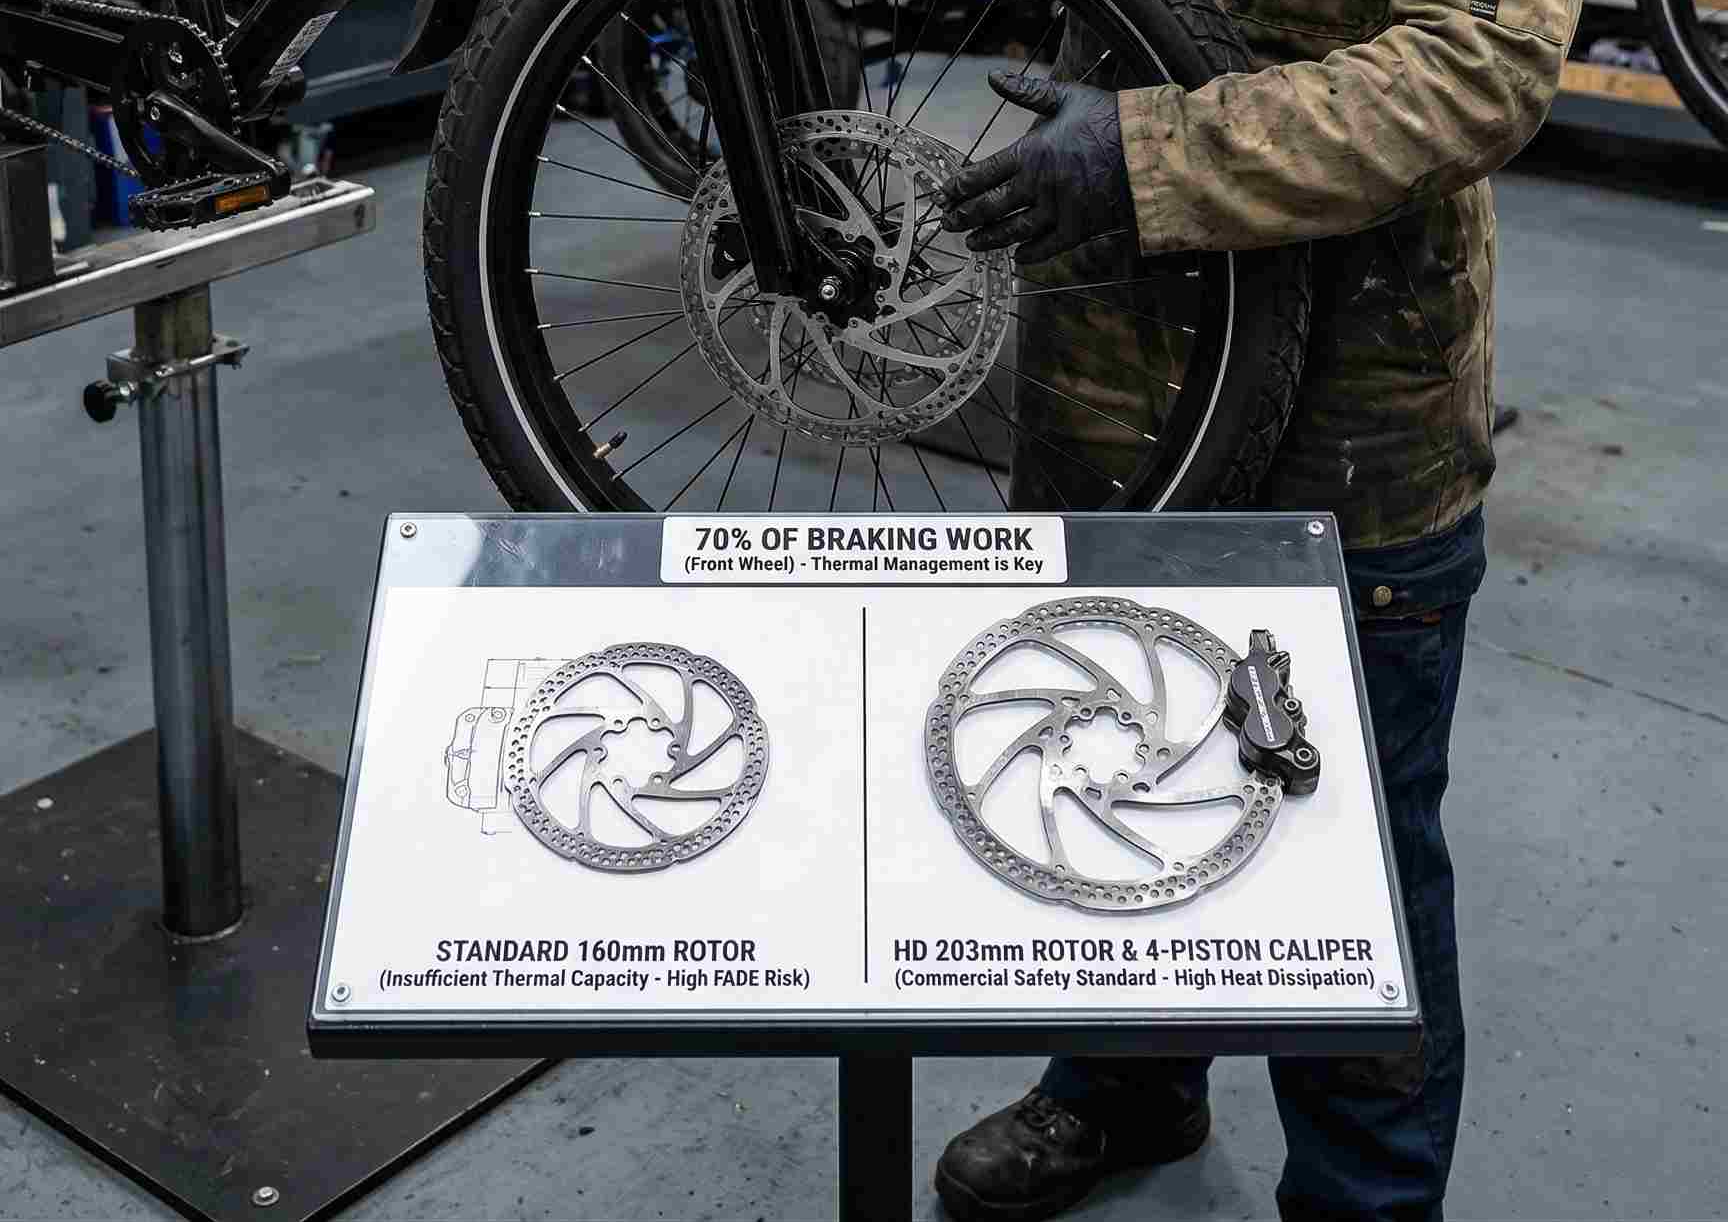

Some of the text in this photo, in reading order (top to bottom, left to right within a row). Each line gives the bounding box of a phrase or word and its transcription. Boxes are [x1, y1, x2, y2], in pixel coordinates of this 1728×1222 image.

[695, 527, 1033, 551] 70% OF BRAKING WORK
[684, 555, 734, 575] (Front
[738, 555, 795, 575] Wheel)
[810, 555, 879, 571] Thermal
[883, 556, 990, 575] Management
[994, 556, 1009, 571] is
[1014, 556, 1044, 575] Key
[436, 939, 756, 962] STANDARD 160mm ROTOR
[894, 938, 1373, 962] HD 203mm ROTOR & 4-PISTON CALIPER
[379, 969, 488, 992] (Insufficient
[492, 968, 566, 987] Thermal
[571, 969, 649, 992] Capacity
[667, 968, 708, 991] High
[714, 969, 760, 987] FADE
[765, 968, 810, 990] Risk)
[895, 968, 1009, 990] (Commercial
[1014, 968, 1071, 991] Safety
[1076, 968, 1157, 987] Standard
[1174, 968, 1217, 991] High
[1221, 969, 1263, 986] Heat
[1267, 967, 1375, 990] Dissipation)
